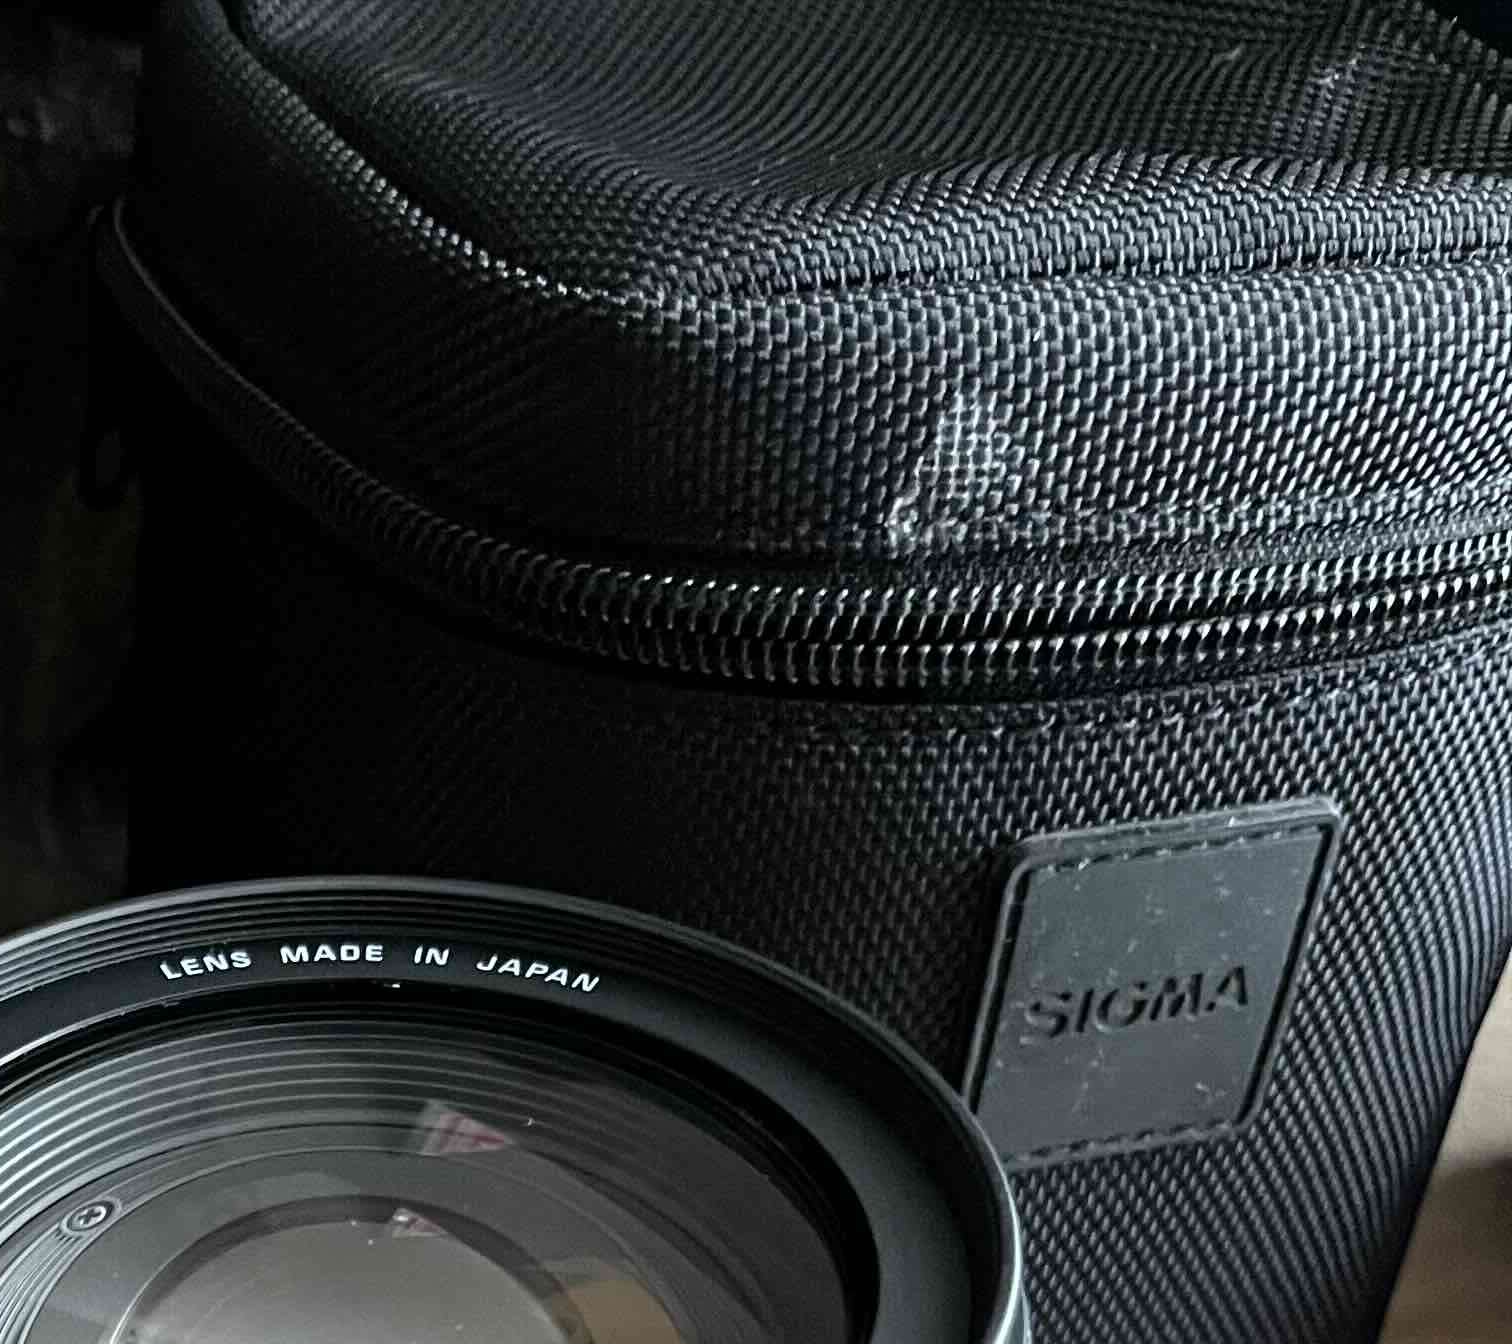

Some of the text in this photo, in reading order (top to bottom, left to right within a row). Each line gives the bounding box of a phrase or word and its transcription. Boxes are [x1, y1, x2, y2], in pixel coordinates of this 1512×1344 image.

[160, 944, 600, 993] LENS MADE IN JAPAN
[1028, 966, 1248, 1039] SIGMA
